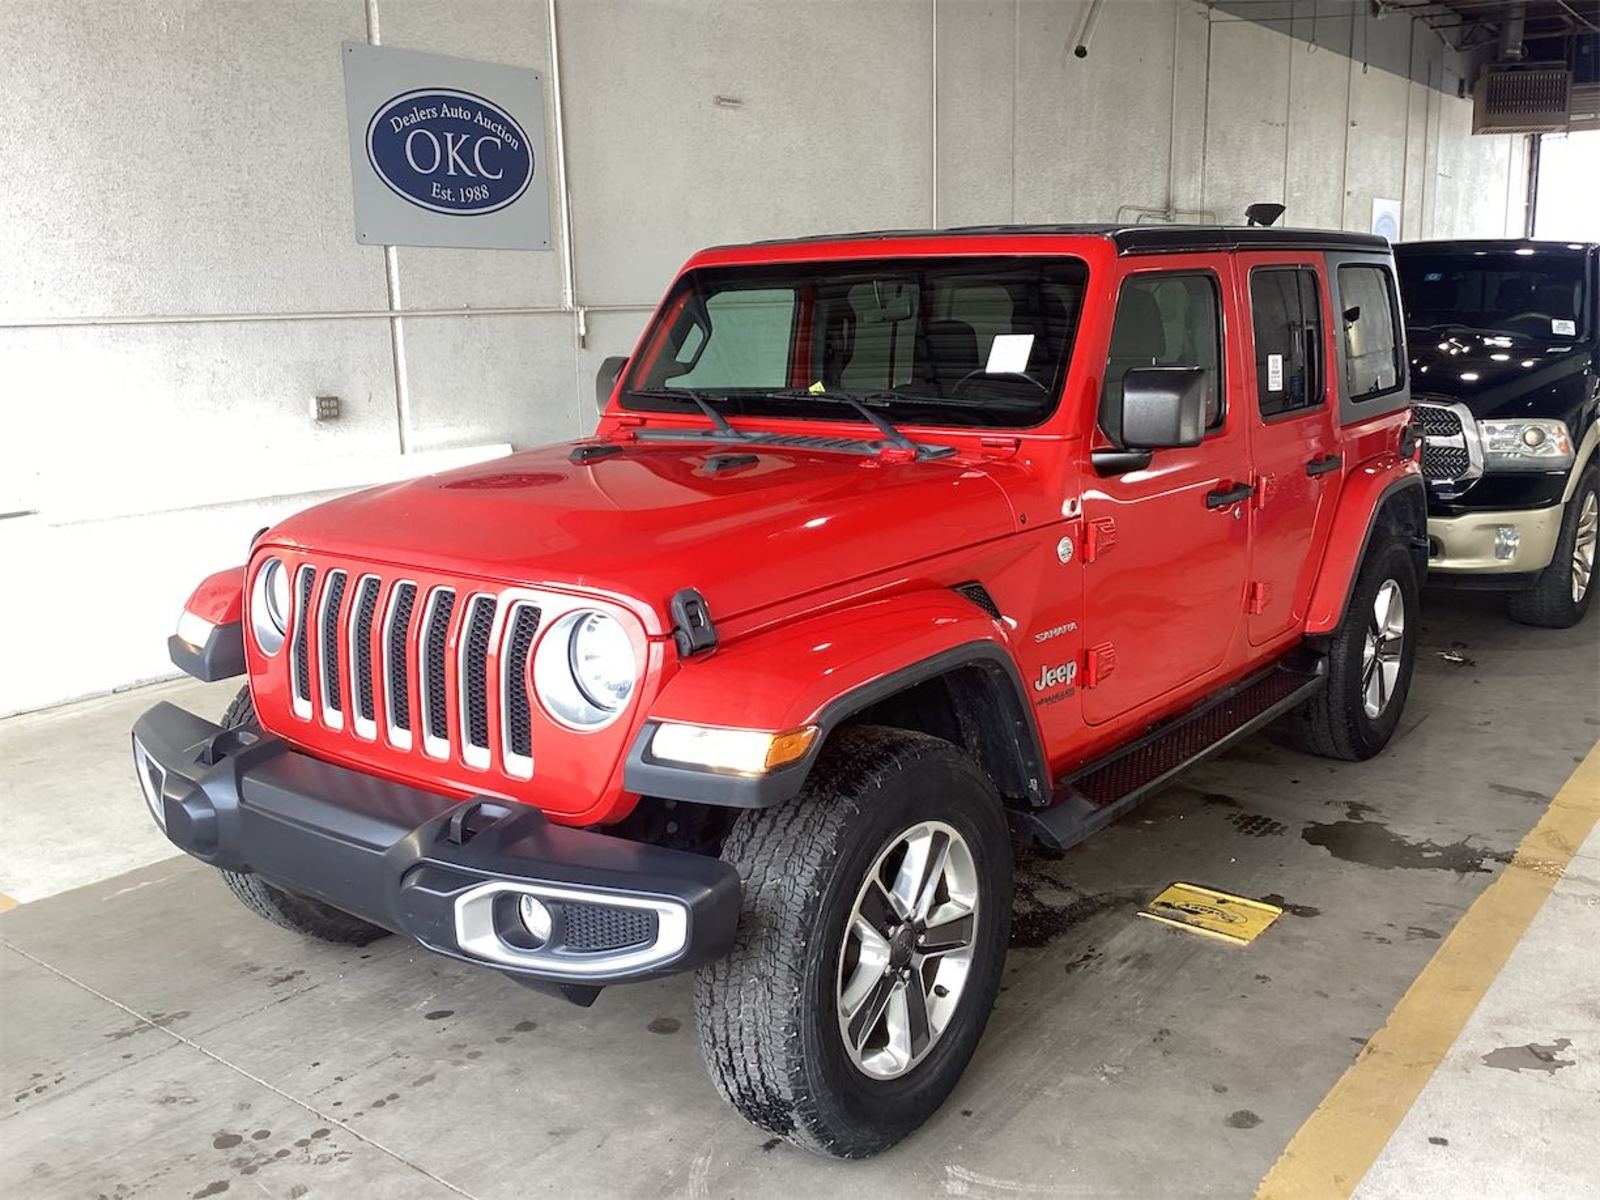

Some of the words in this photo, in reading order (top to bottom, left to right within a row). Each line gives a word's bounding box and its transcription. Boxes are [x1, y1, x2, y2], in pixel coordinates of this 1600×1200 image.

[390, 107, 438, 133] Dealers
[440, 103, 471, 120] Auto
[474, 111, 520, 151] Auction
[405, 129, 503, 180] OKC
[431, 182, 456, 201] Est.
[460, 184, 490, 203] 1988
[1034, 621, 1078, 643] SAHARA
[1034, 660, 1078, 691] Jeep
